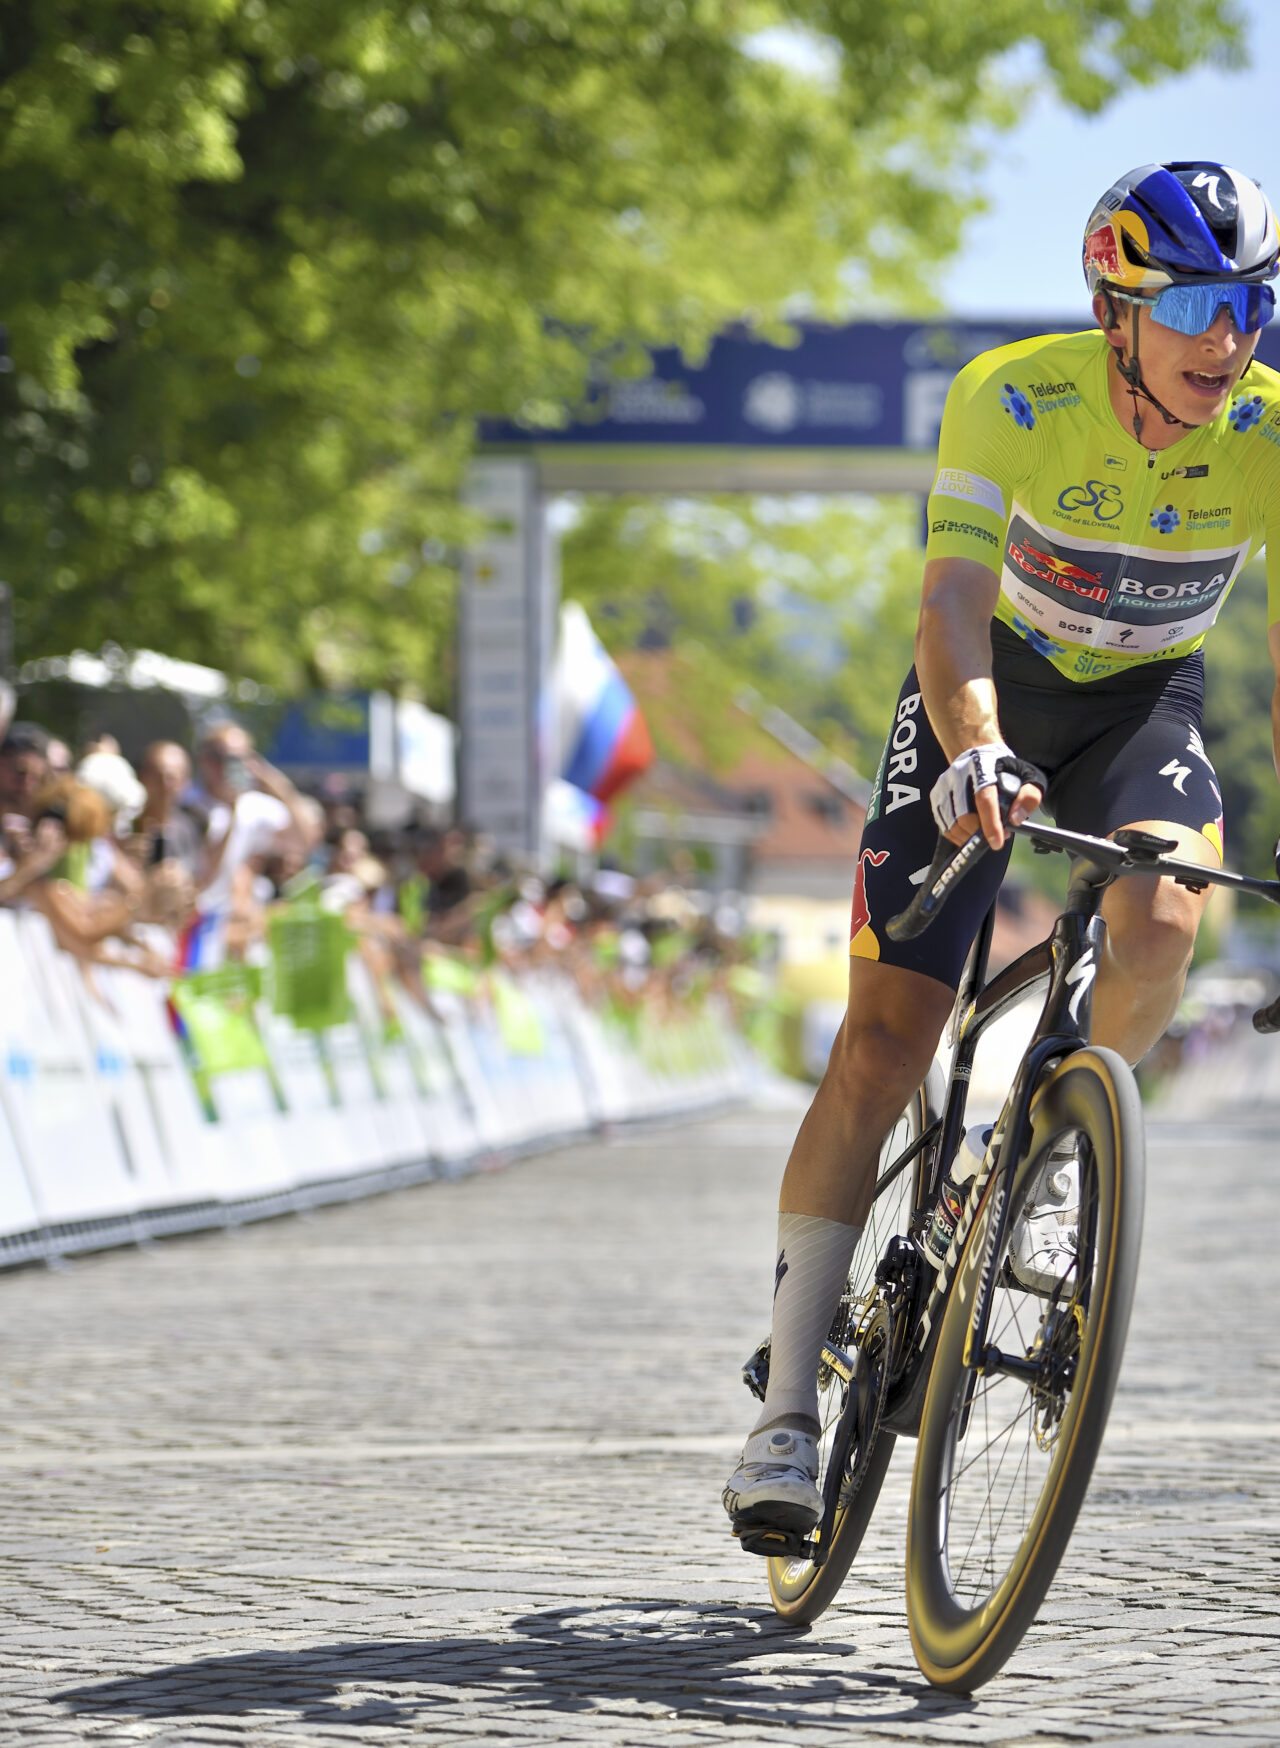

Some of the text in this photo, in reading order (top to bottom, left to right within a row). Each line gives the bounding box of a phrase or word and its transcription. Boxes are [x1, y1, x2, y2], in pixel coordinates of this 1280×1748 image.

[1028, 382, 1077, 398] Telekom
[1036, 394, 1081, 414] Slovenije
[945, 471, 972, 484] FEEL
[1052, 509, 1072, 520] TOUR
[1082, 519, 1120, 530] SLOVENIA
[1187, 506, 1231, 519] Telekom
[948, 521, 999, 543] SLOVENIA
[1186, 518, 1231, 530] Slovenije
[947, 527, 999, 548] BUSINESS
[1009, 541, 1109, 603] Red Bull
[1118, 573, 1226, 599] BORA
[1017, 591, 1044, 616] grenke
[1118, 589, 1219, 608] hansgrohe
[1059, 621, 1092, 634] BOSS
[885, 692, 921, 815] BORA
[932, 834, 981, 898] SRAM
[972, 1190, 1006, 1330] SPECIALIZED
